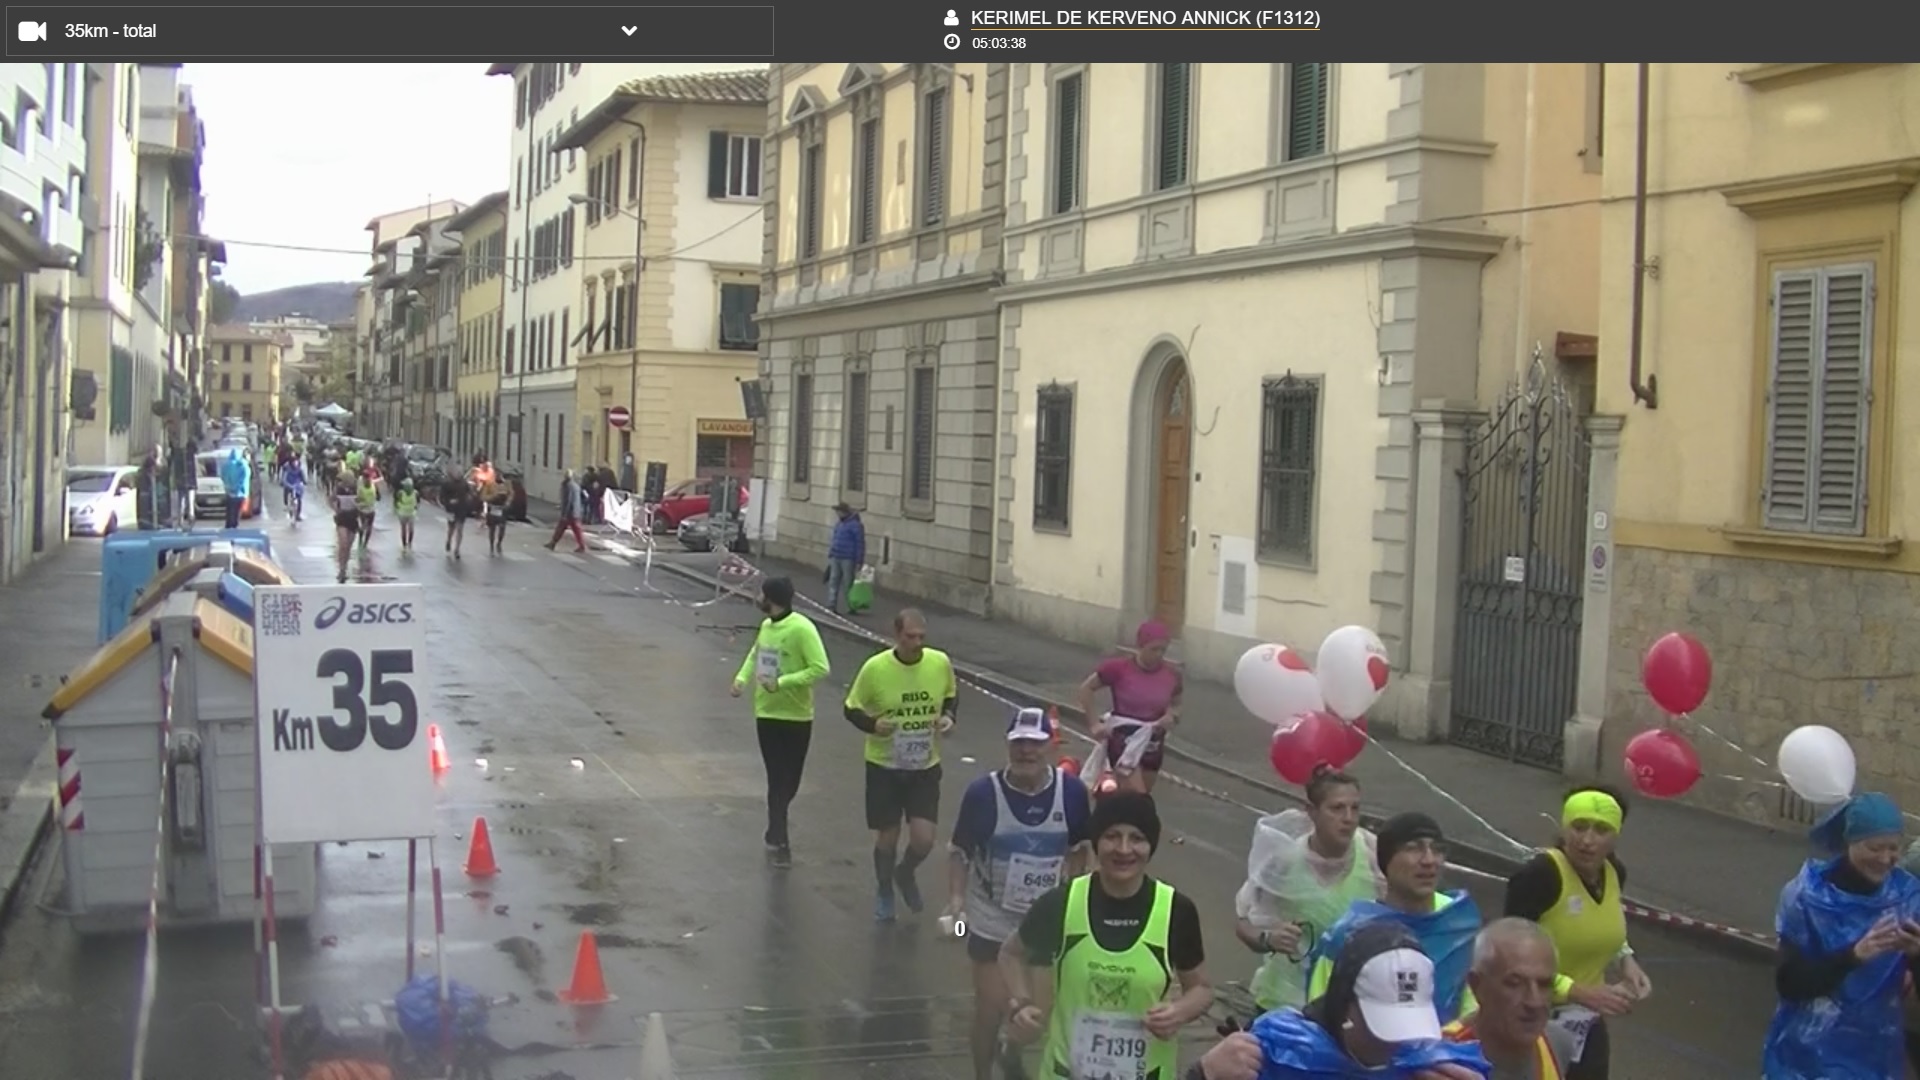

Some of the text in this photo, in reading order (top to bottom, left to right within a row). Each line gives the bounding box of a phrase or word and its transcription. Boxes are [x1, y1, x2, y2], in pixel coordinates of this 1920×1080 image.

[347, 602, 412, 624] asics
[272, 647, 418, 752] Km 35
[1090, 1033, 1147, 1058] F1319
